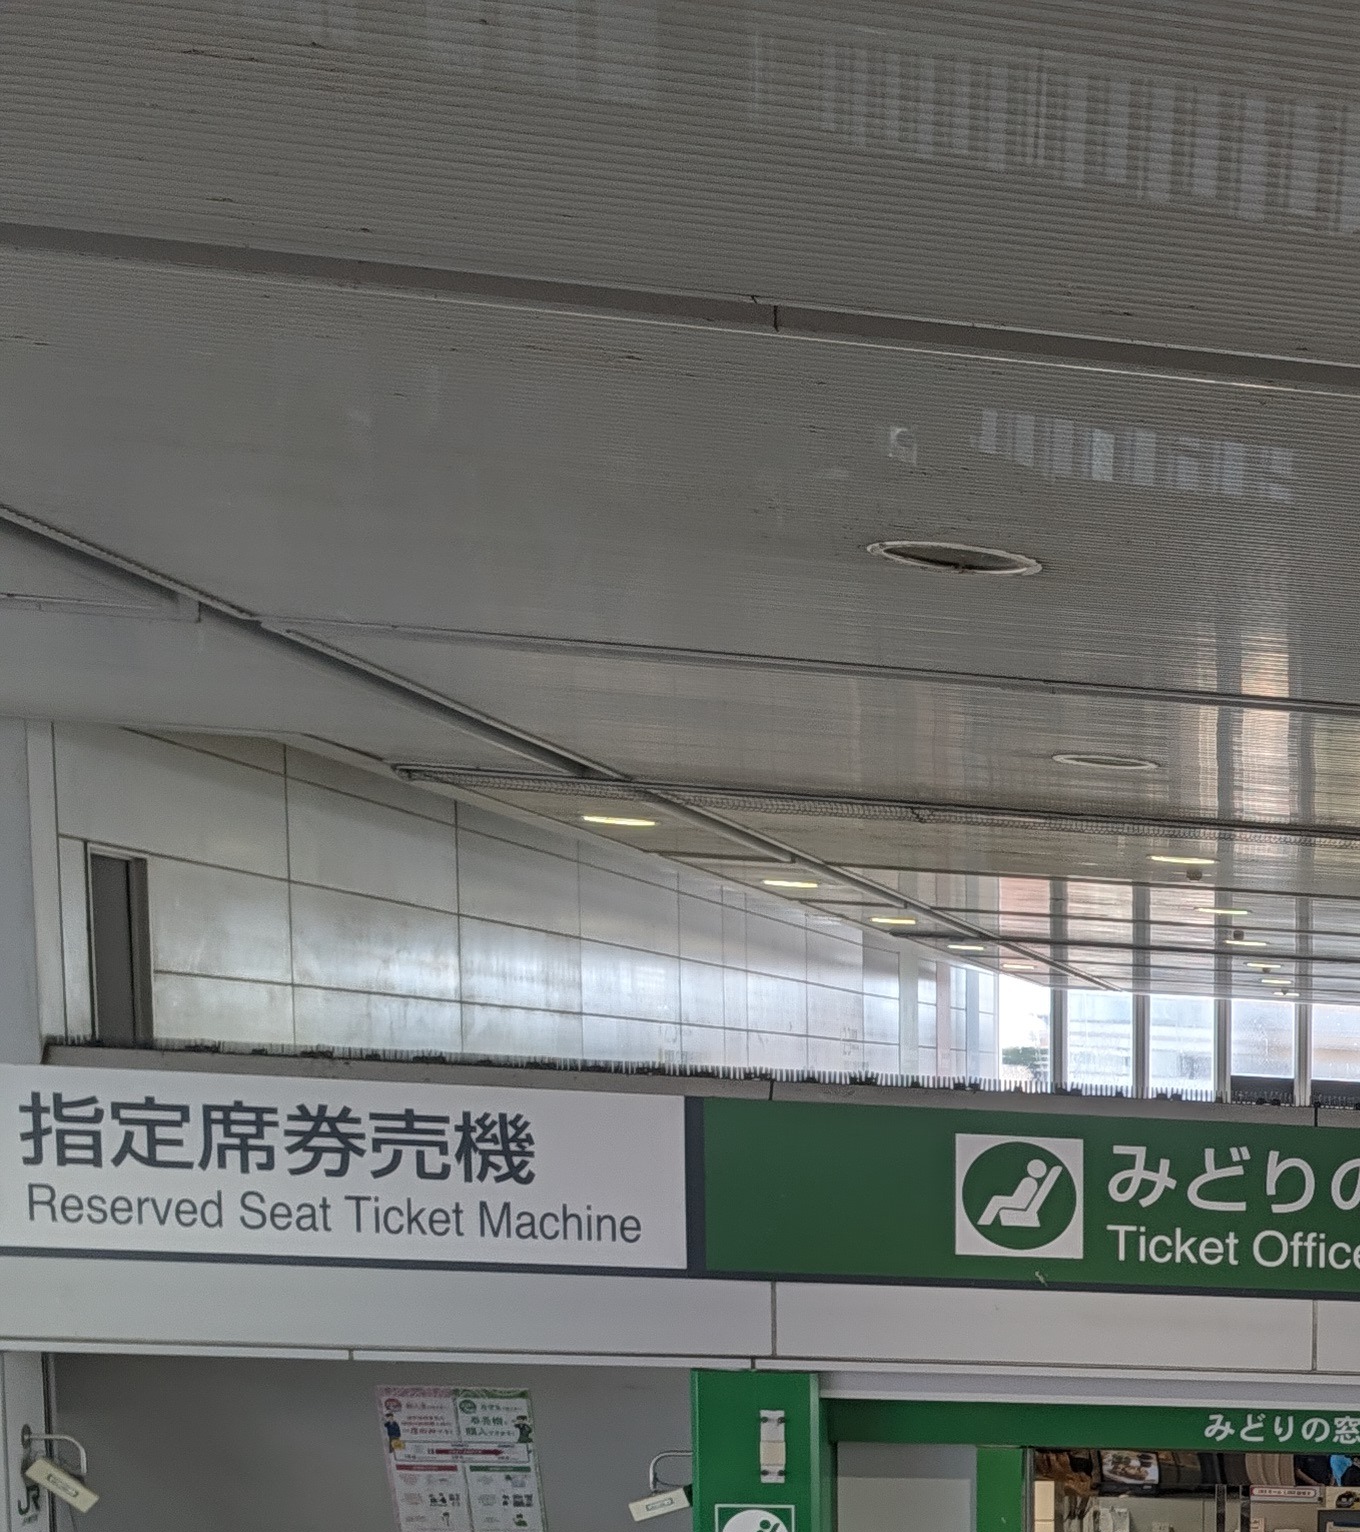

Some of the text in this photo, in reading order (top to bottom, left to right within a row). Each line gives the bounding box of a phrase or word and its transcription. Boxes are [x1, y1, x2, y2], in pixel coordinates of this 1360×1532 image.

[19, 1092, 537, 1184] 指定席券売機
[27, 1184, 643, 1243] Reserved Seat Ticket Machine
[1107, 1225, 1239, 1266] Ticket
